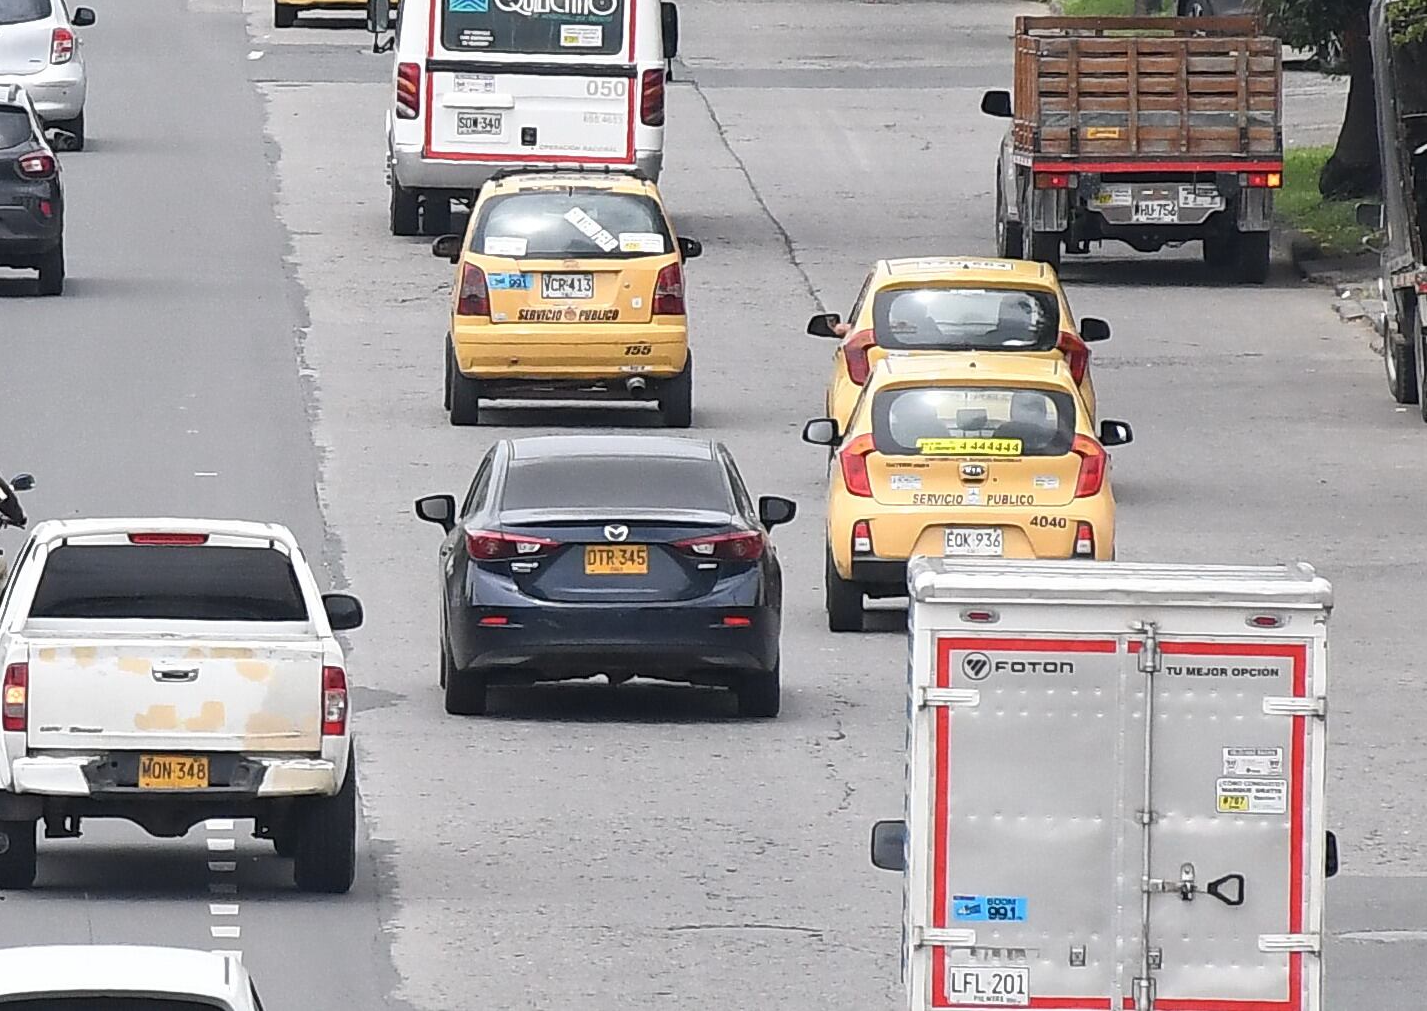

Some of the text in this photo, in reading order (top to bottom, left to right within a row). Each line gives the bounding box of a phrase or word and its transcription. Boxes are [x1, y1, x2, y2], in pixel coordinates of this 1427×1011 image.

[587, 80, 626, 97] 050
[518, 309, 619, 321] SERVICIO PUBLICO
[624, 345, 652, 356] 155
[913, 494, 1034, 505] SERVICIO PUBLICO
[1029, 516, 1067, 529] 4040
[995, 661, 1074, 674] FOTON
[1165, 667, 1182, 676] TU
[1186, 667, 1228, 677] MEJOR
